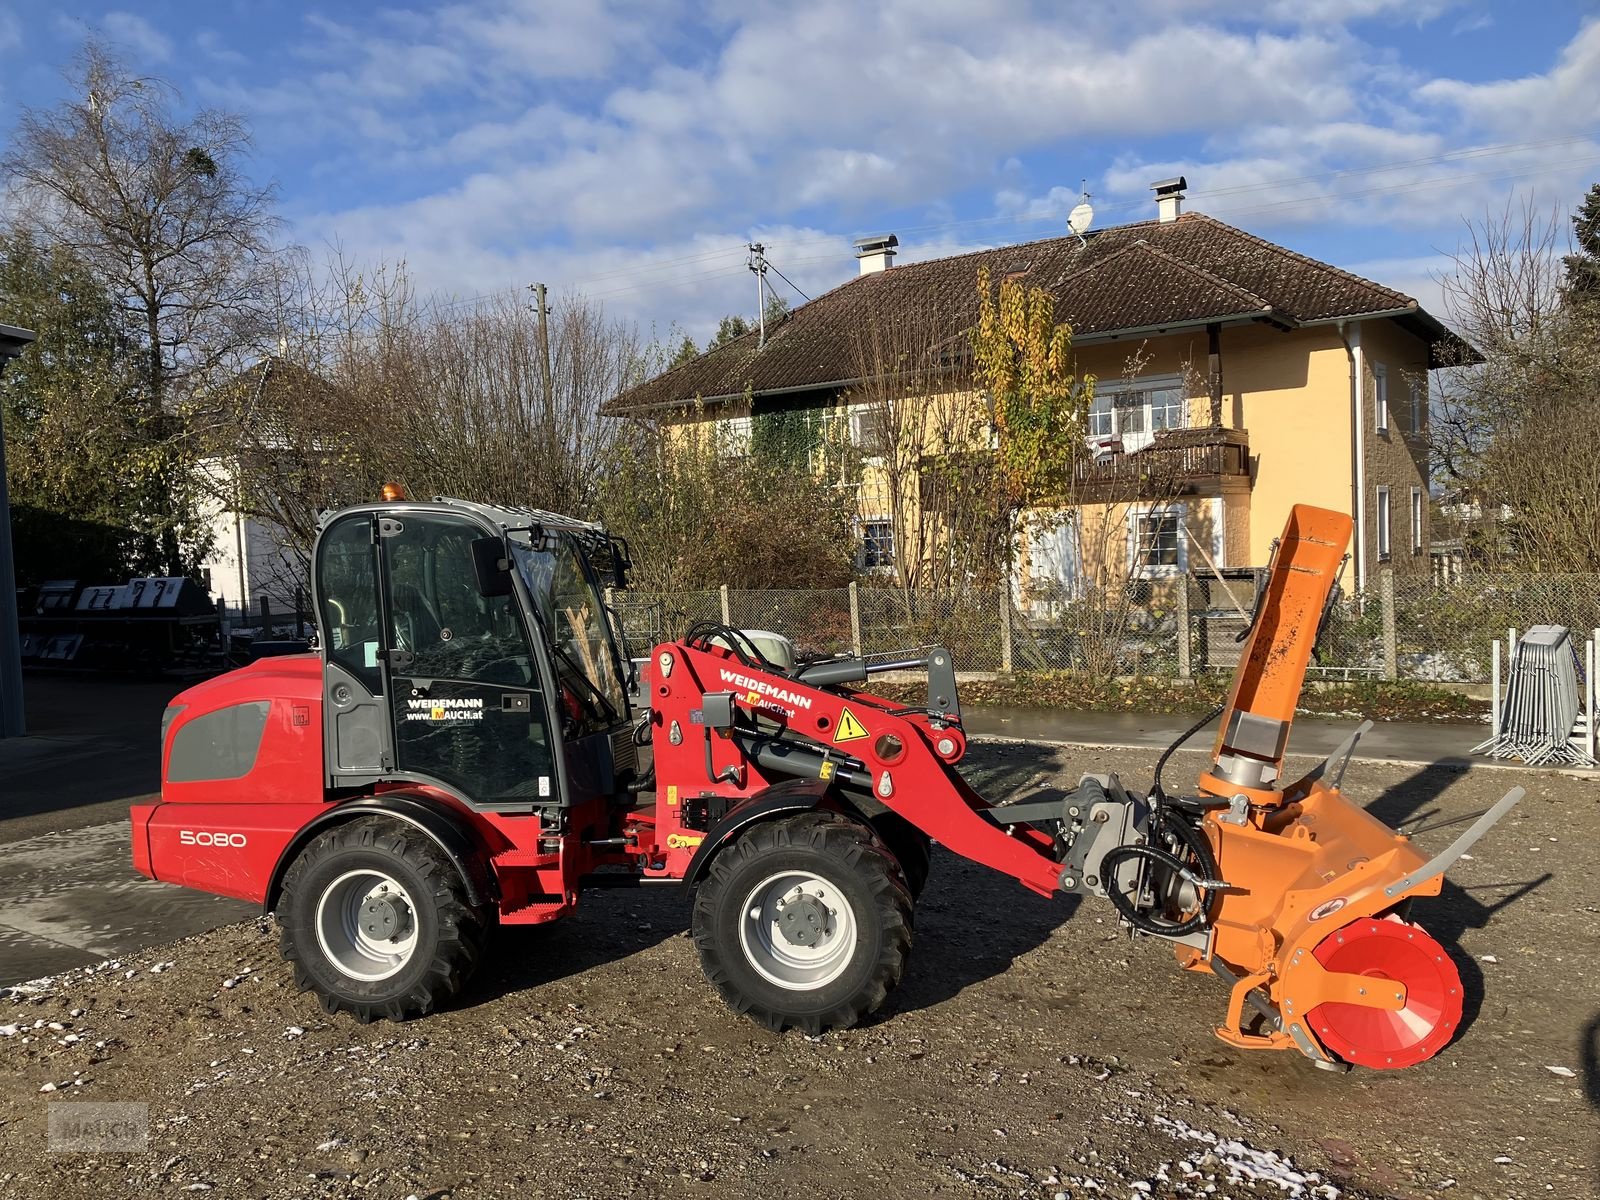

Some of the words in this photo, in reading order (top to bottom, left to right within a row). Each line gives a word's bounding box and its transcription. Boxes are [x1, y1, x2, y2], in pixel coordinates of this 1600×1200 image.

[720, 668, 812, 710] WEIDEMANN
[407, 699, 483, 709] WEIDEMANN
[722, 688, 796, 718] w.MAUCH.at
[406, 709, 484, 721] www.MAUCH.at
[180, 830, 247, 848] 5080
